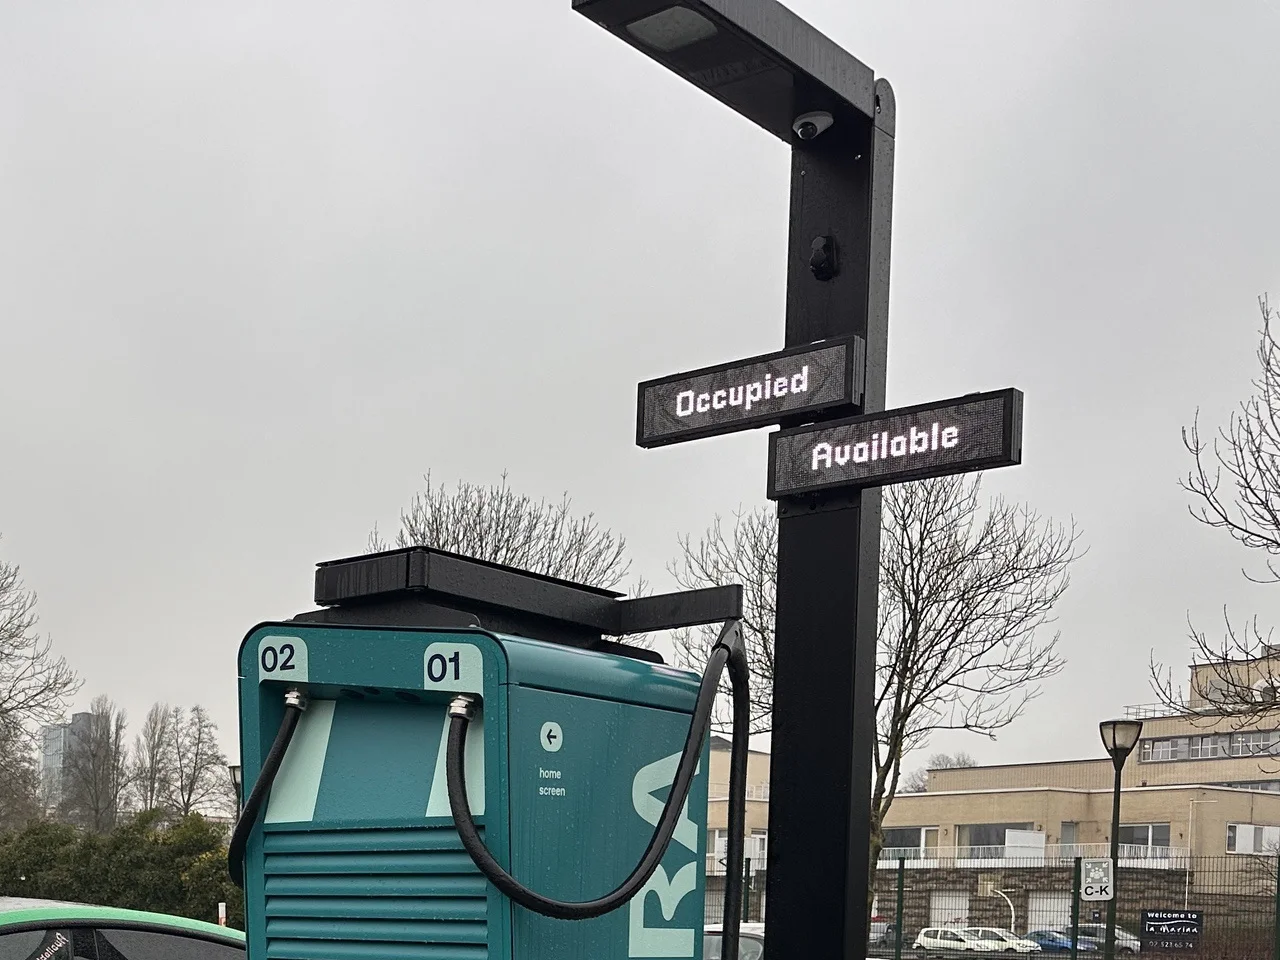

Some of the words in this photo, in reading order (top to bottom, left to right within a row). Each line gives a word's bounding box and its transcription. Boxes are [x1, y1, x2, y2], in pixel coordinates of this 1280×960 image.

[676, 365, 808, 417] Occupied
[812, 422, 960, 471] Available
[261, 644, 296, 673] 02
[427, 651, 460, 683] 01
[539, 767, 561, 779] home
[539, 785, 566, 797] screen
[1084, 885, 1109, 896] C-K
